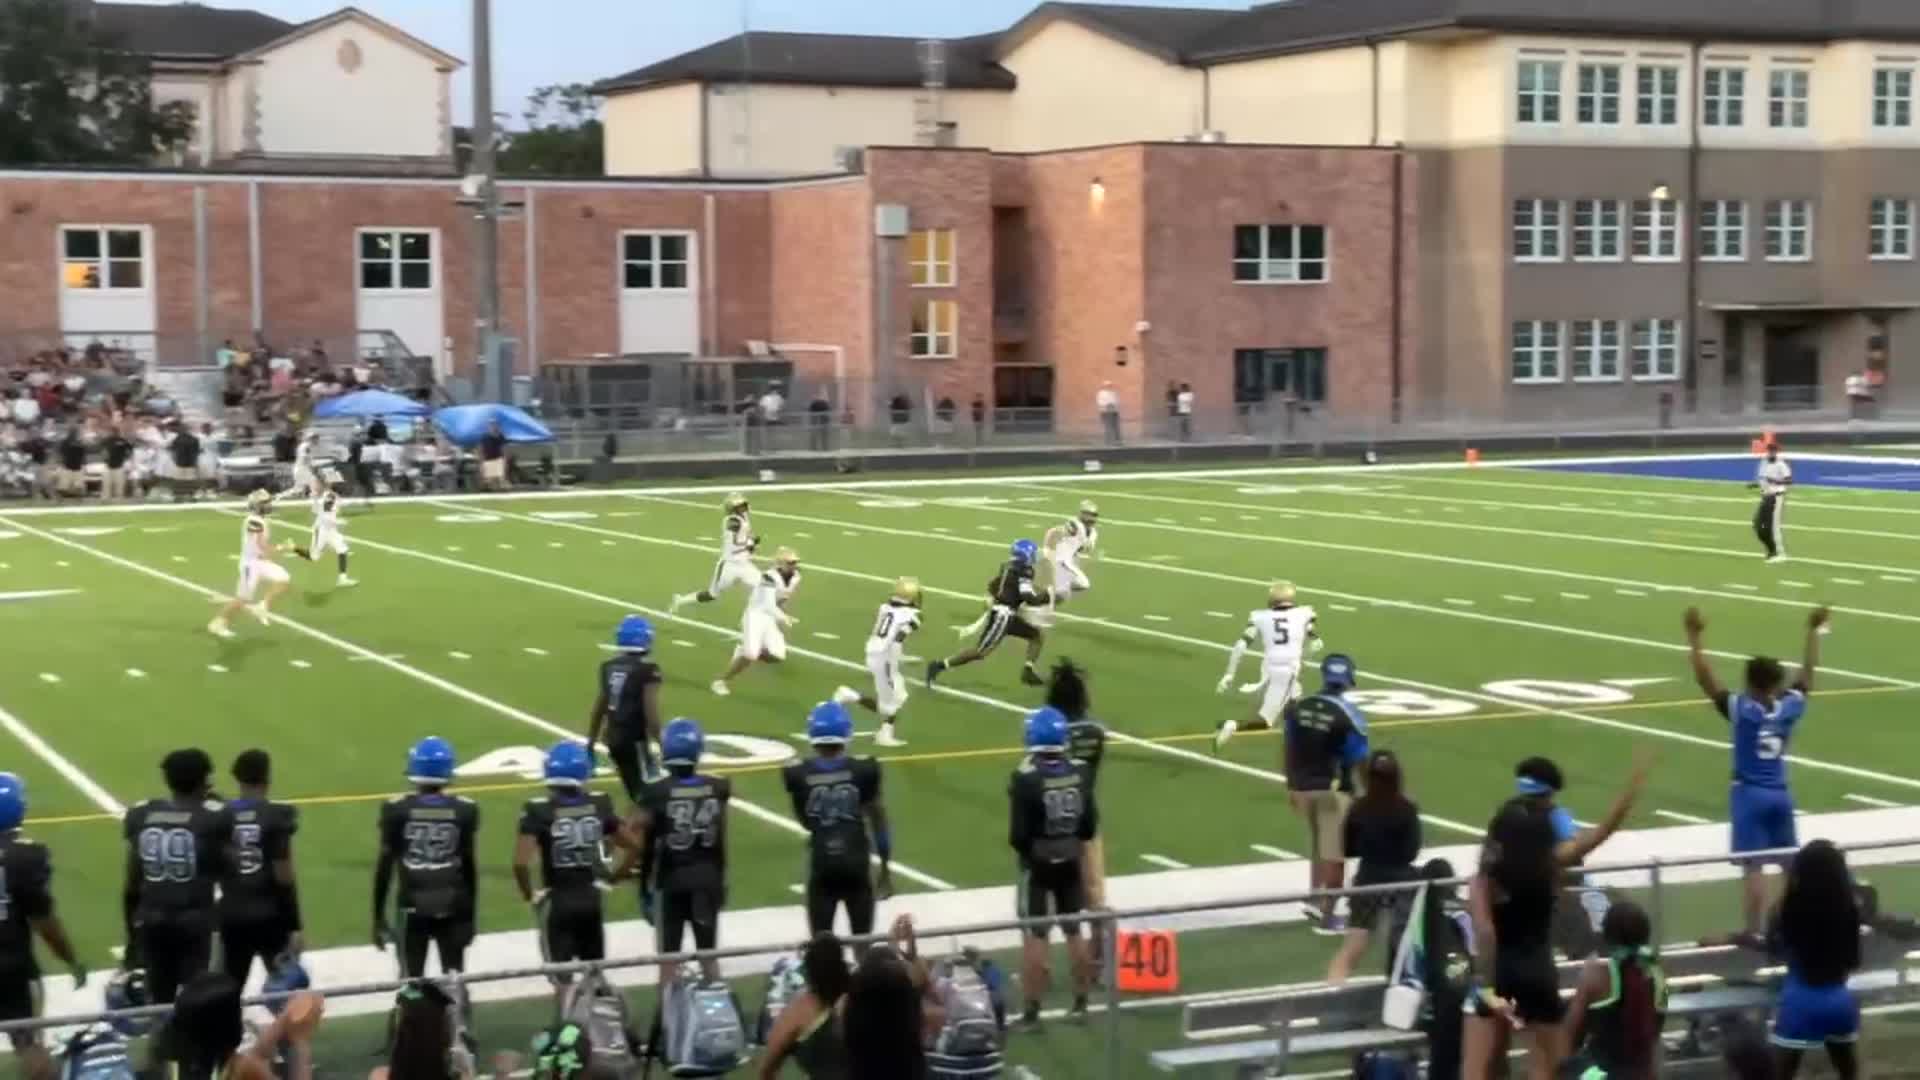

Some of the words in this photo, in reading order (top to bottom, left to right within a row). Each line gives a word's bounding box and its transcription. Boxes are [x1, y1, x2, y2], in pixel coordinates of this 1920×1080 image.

[1273, 617, 1289, 645] 5
[1756, 731, 1782, 760] 5
[665, 798, 721, 850] 34
[138, 826, 196, 883] 99
[1119, 934, 1170, 977] 40
